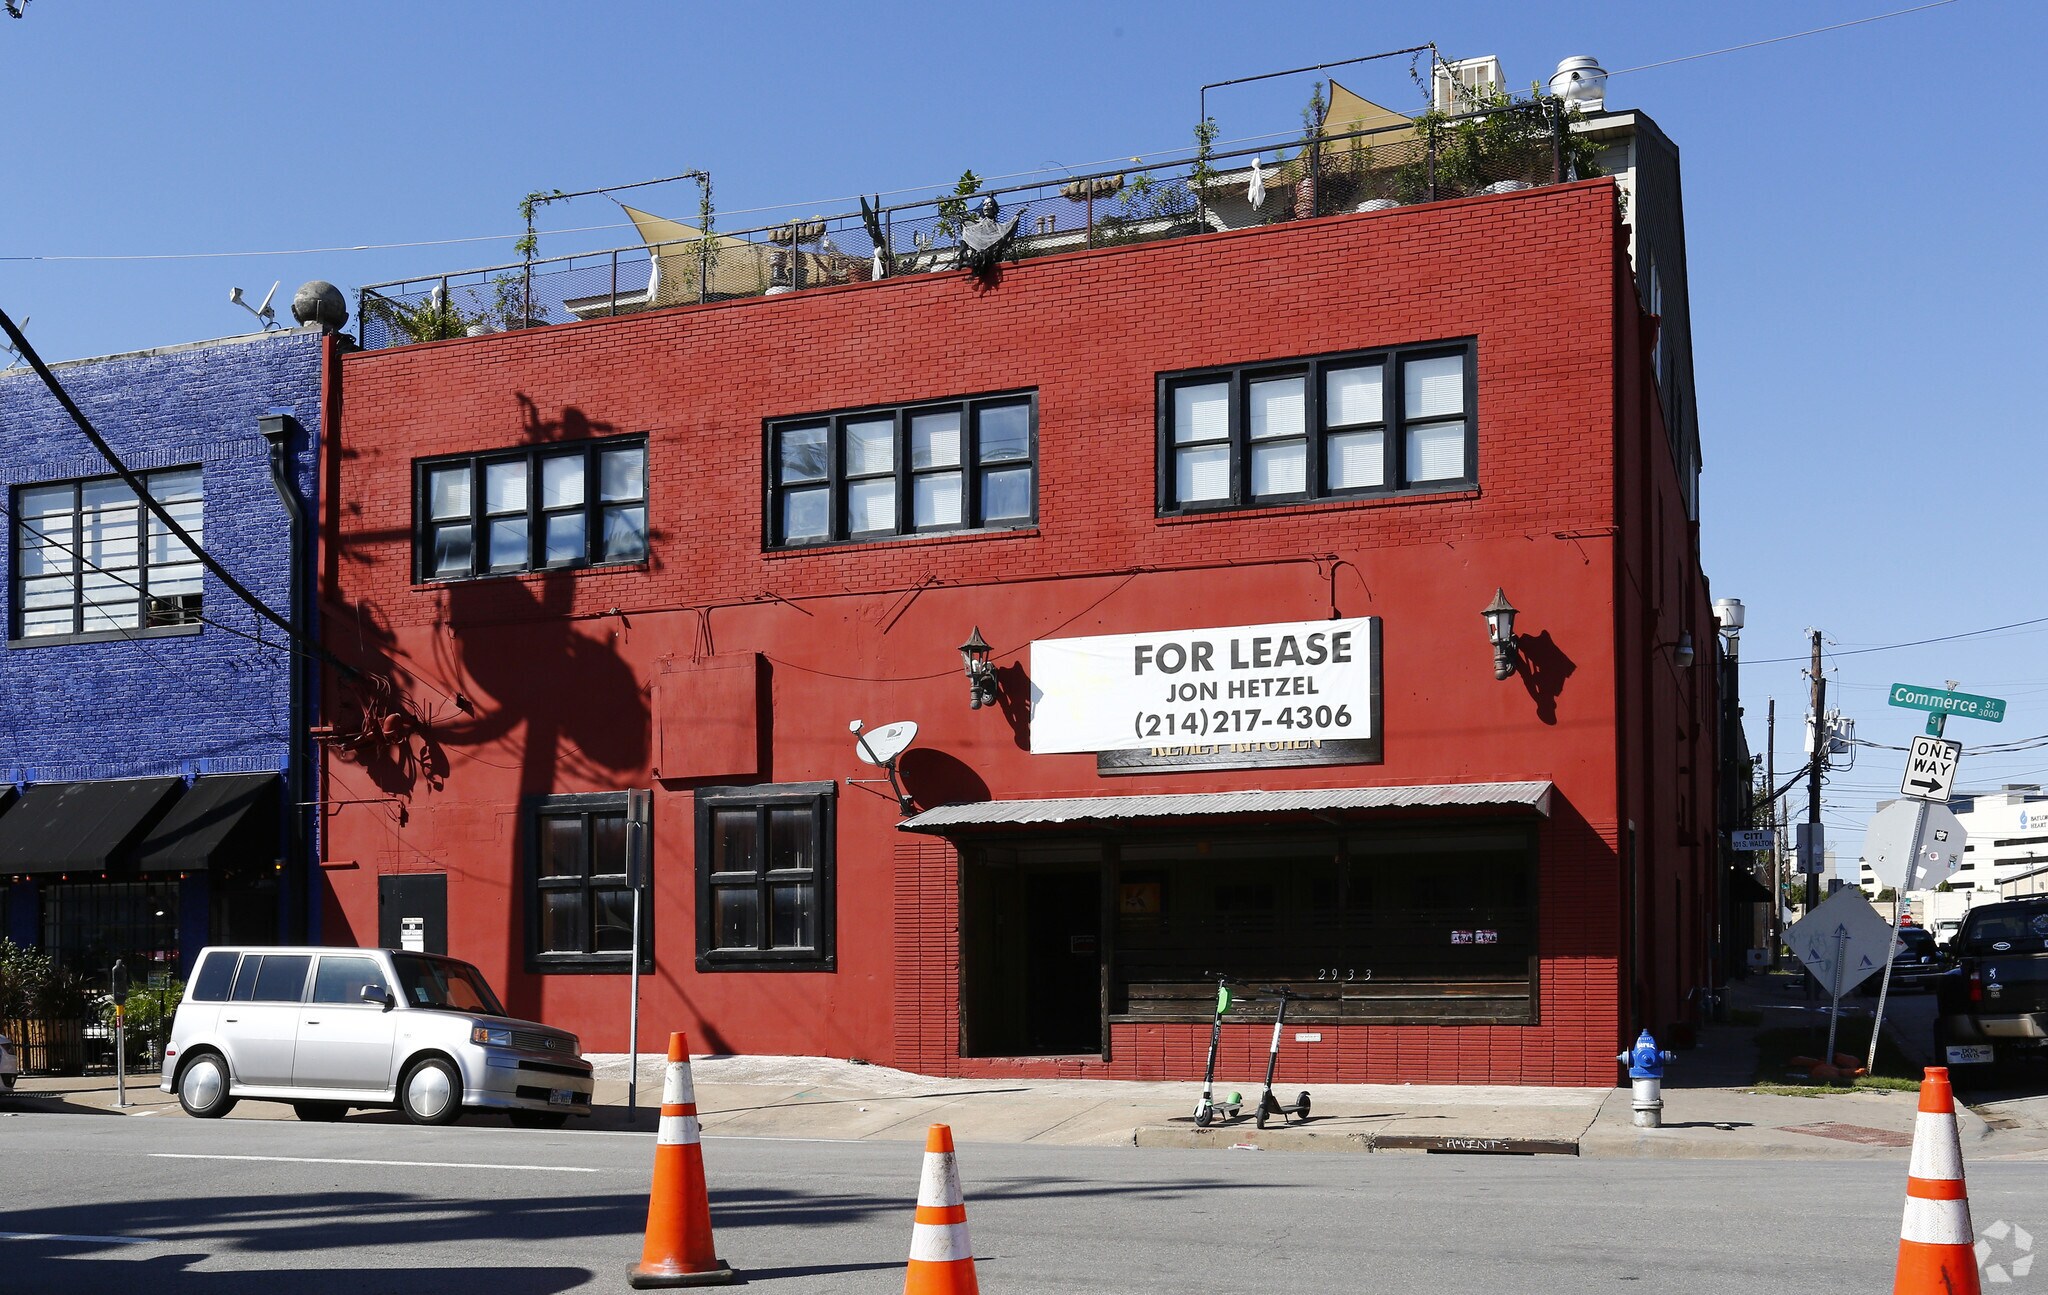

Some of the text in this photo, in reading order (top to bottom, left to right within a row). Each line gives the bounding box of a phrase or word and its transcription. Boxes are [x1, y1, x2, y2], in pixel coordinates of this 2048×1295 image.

[1134, 631, 1352, 676] FOR LEASE
[1166, 675, 1319, 703] JON HETZEL
[1895, 687, 1995, 713] Commerce St
[1134, 704, 1352, 739] (214)217-4306
[1977, 708, 2000, 719] 3000
[1917, 742, 1955, 761] ONE
[1913, 757, 1952, 776] WAY
[1317, 968, 1372, 981] 2933
